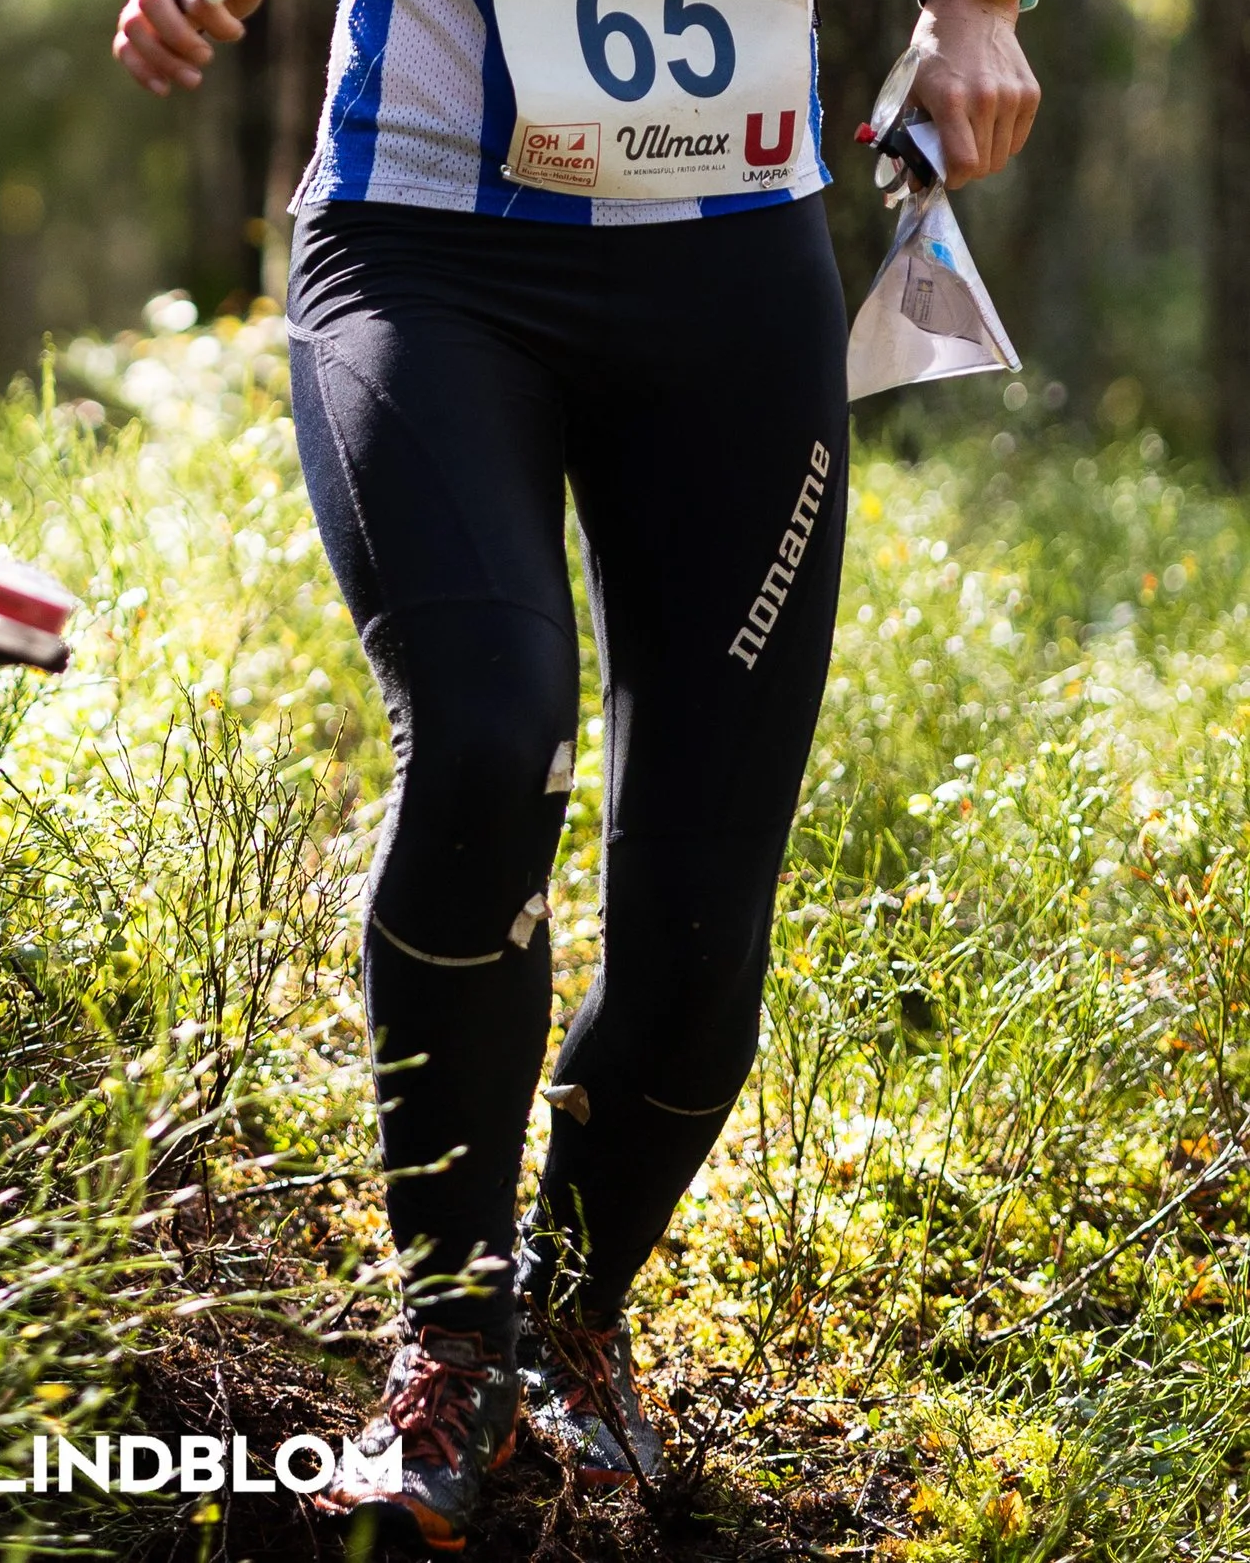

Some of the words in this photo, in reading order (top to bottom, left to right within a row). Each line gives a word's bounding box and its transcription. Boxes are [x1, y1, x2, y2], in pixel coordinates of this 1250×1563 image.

[526, 149, 595, 170] Tisaren
[742, 168, 789, 183] UMARA
[728, 440, 830, 670] noname
